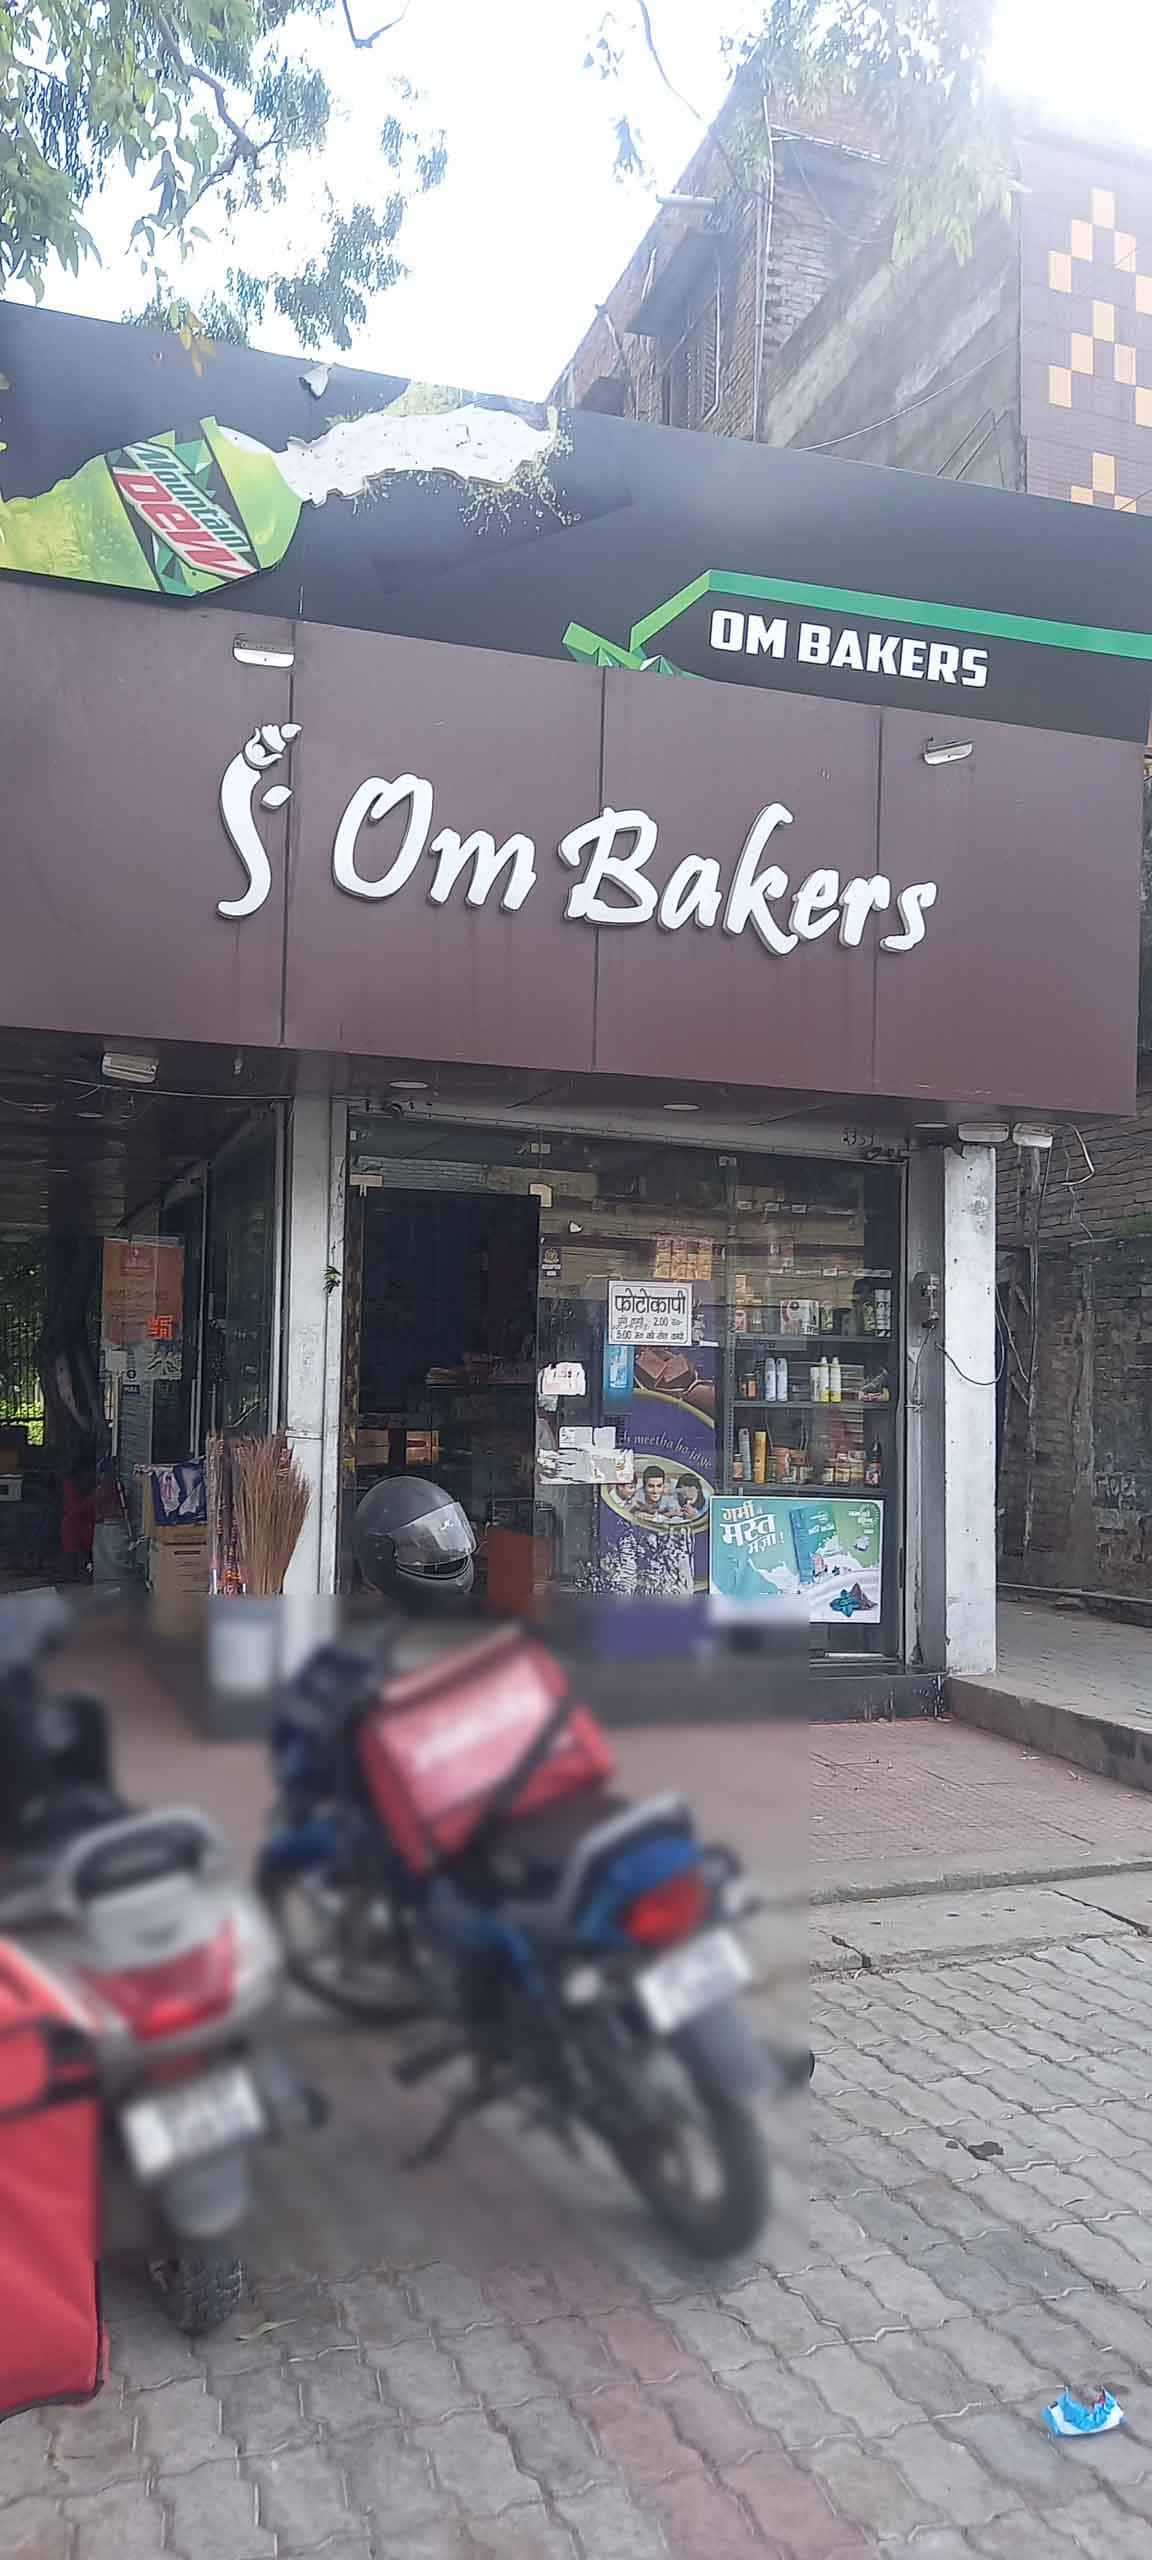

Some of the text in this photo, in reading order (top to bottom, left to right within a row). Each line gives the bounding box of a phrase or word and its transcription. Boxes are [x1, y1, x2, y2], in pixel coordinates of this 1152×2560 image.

[130, 444, 252, 549] Mountain
[710, 608, 989, 688] OM BAKERS
[332, 772, 938, 956] Om Bakers
[634, 1431, 673, 1449] meetha
